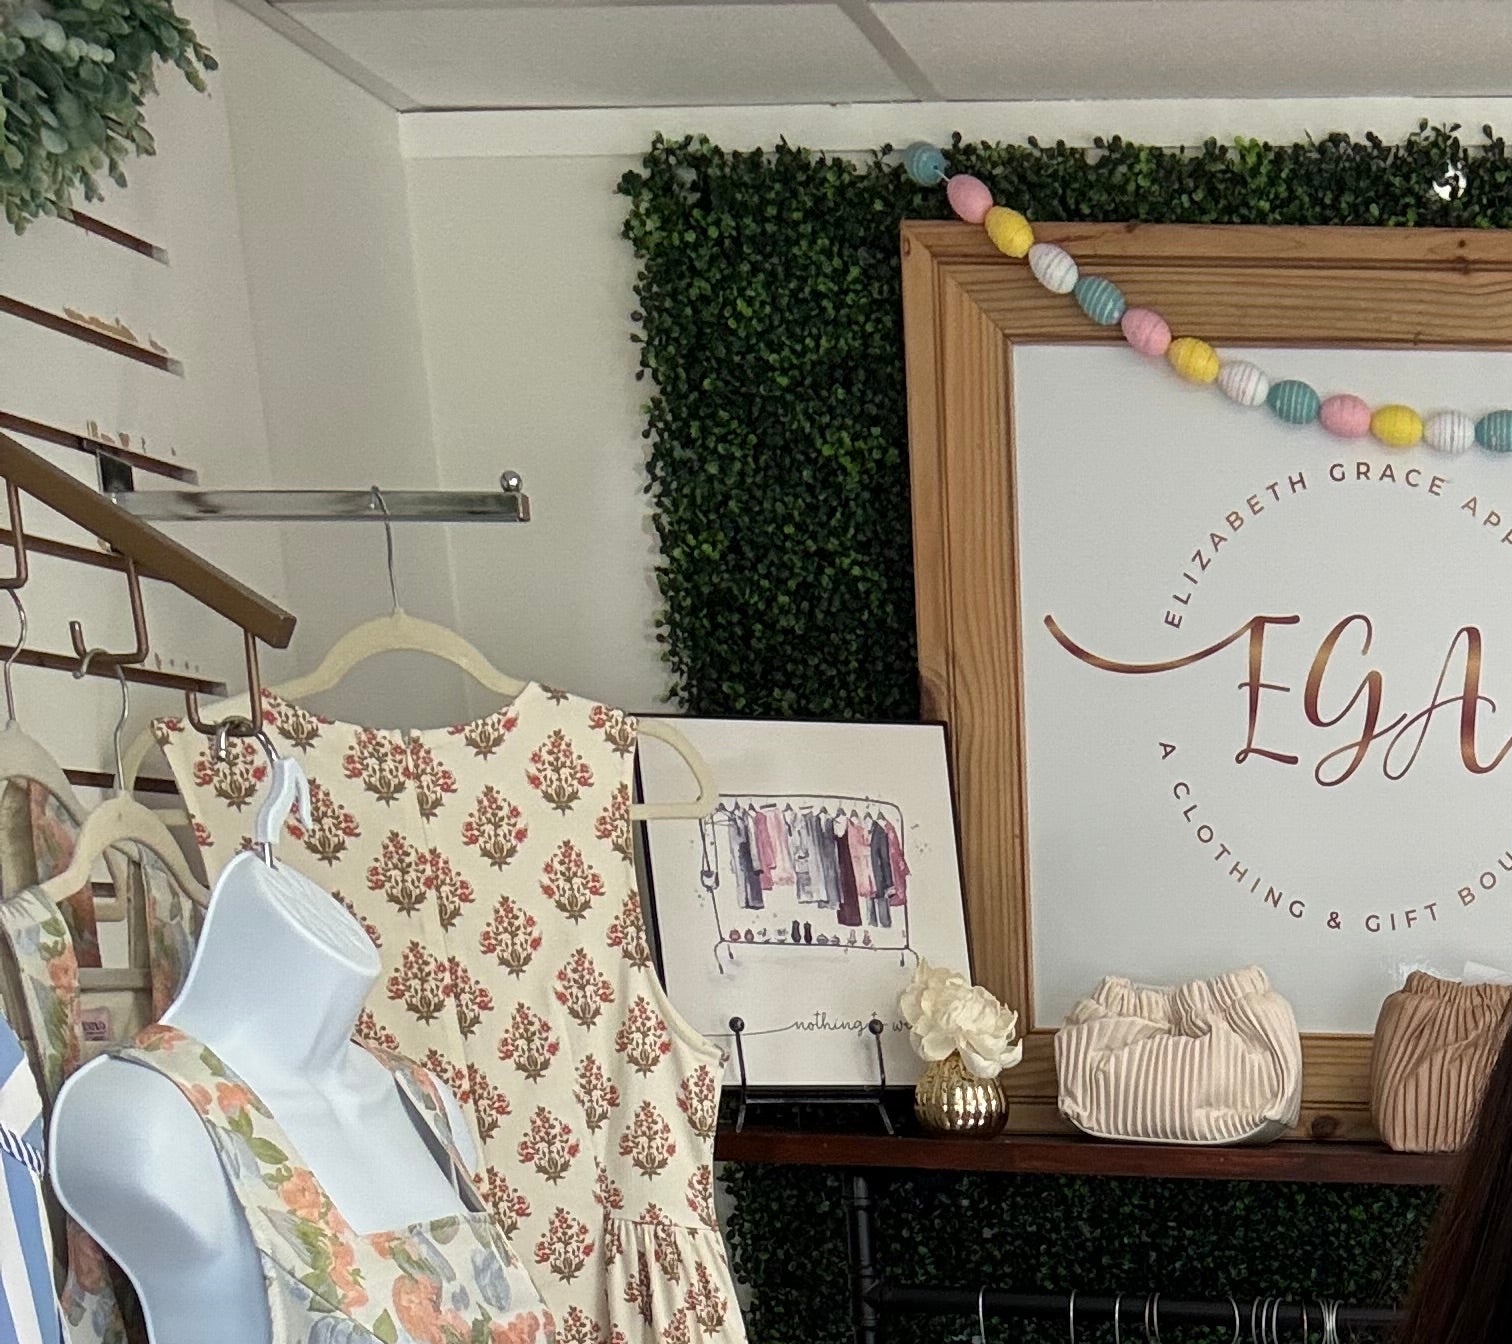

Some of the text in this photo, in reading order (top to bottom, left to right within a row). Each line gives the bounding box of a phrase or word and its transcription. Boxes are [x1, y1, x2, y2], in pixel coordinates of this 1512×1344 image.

[1163, 471, 1308, 630] ELIZABETH
[1329, 461, 1450, 497] GRACE
[1158, 741, 1177, 761] A
[1173, 781, 1306, 919] CLOTHING
[1326, 911, 1342, 930] &
[1364, 902, 1438, 933] GIFT
[791, 1010, 869, 1037] nothing
